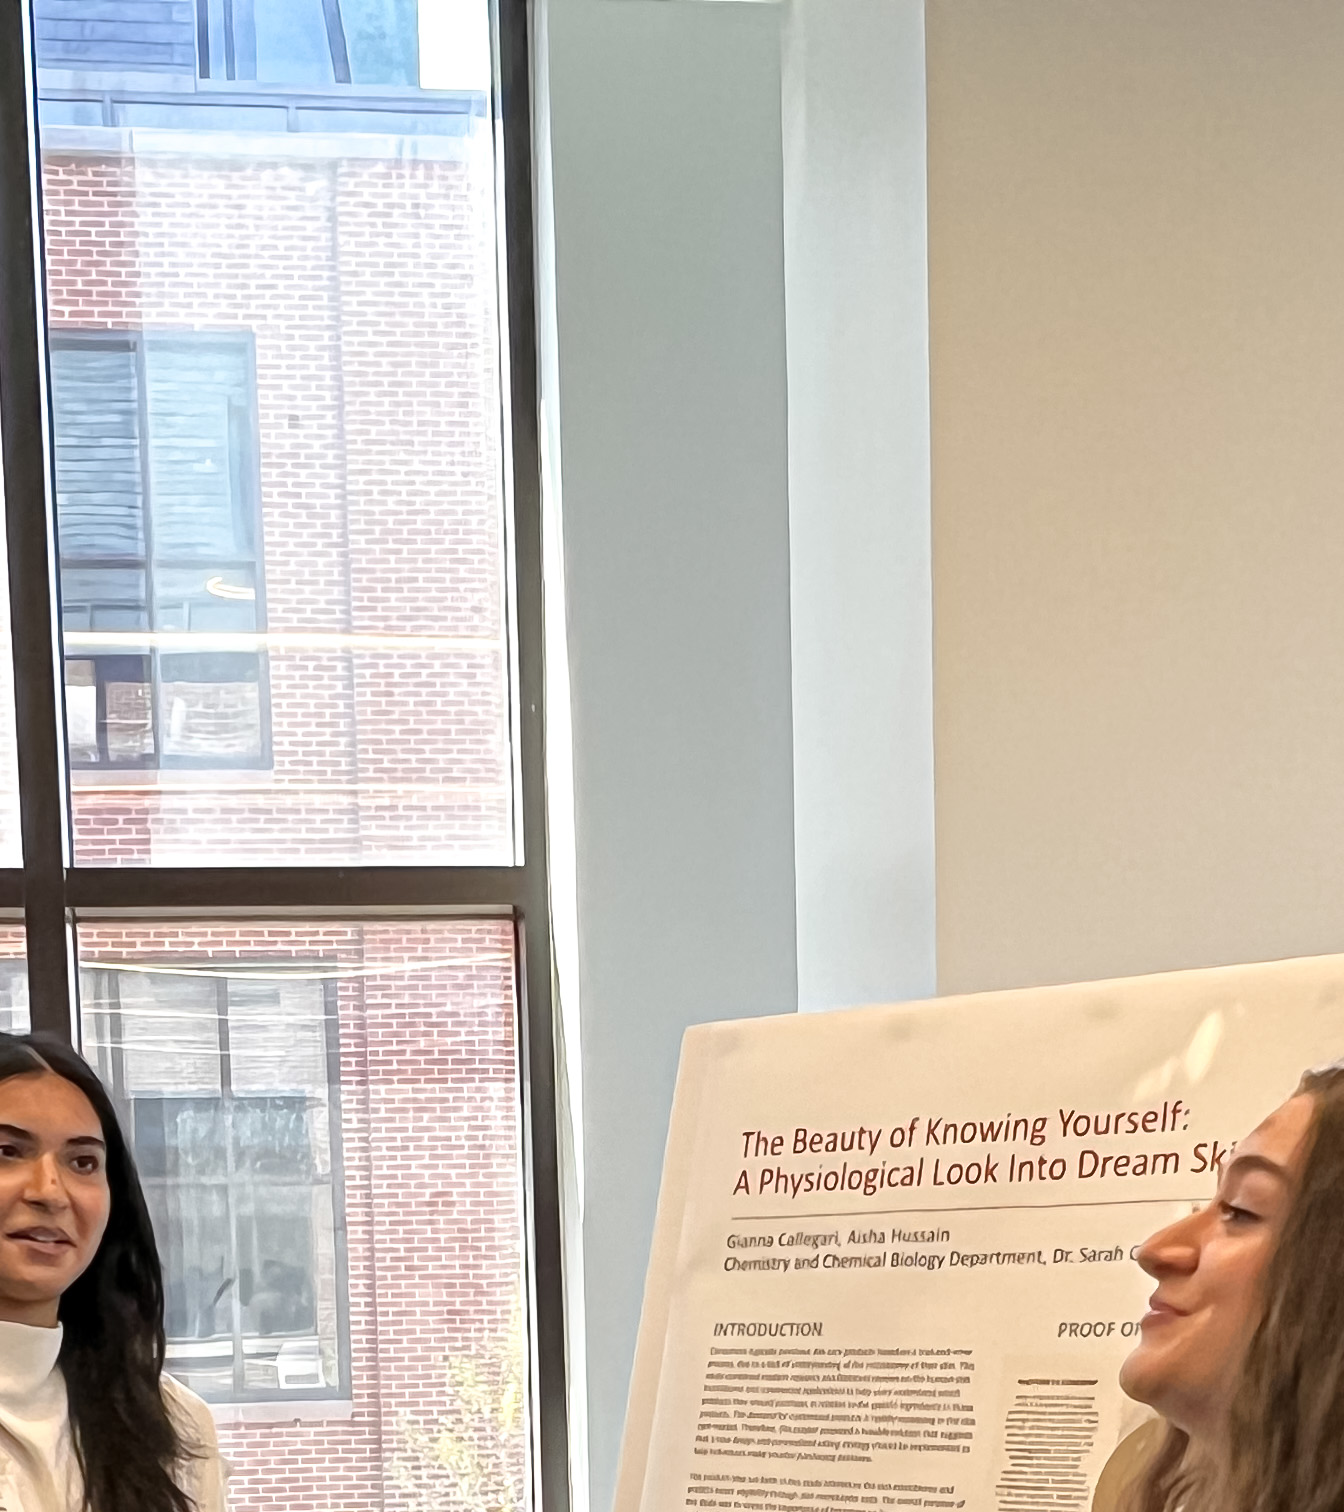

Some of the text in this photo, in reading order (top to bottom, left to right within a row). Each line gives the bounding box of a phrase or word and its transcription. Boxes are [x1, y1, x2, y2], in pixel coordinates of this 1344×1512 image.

[741, 1099, 1191, 1159] The Beauty of Knowing Yourself:
[732, 1174, 752, 1198] A
[758, 1155, 924, 1199] Physiological
[932, 1151, 998, 1185] Look
[1008, 1149, 1067, 1182] Into
[1077, 1145, 1180, 1179] Dream
[847, 1229, 886, 1245] Aisha
[891, 1227, 951, 1244] Hussain
[723, 1255, 791, 1274] Chemistry
[793, 1253, 819, 1270] and
[822, 1251, 887, 1270] Chemical
[890, 1252, 946, 1271] Biology
[950, 1249, 1047, 1269] Department,
[1052, 1247, 1074, 1264] Dr.
[1079, 1246, 1125, 1263] Sarah
[712, 1321, 824, 1339] INTRODUCTION
[1057, 1321, 1116, 1339] PROOF
